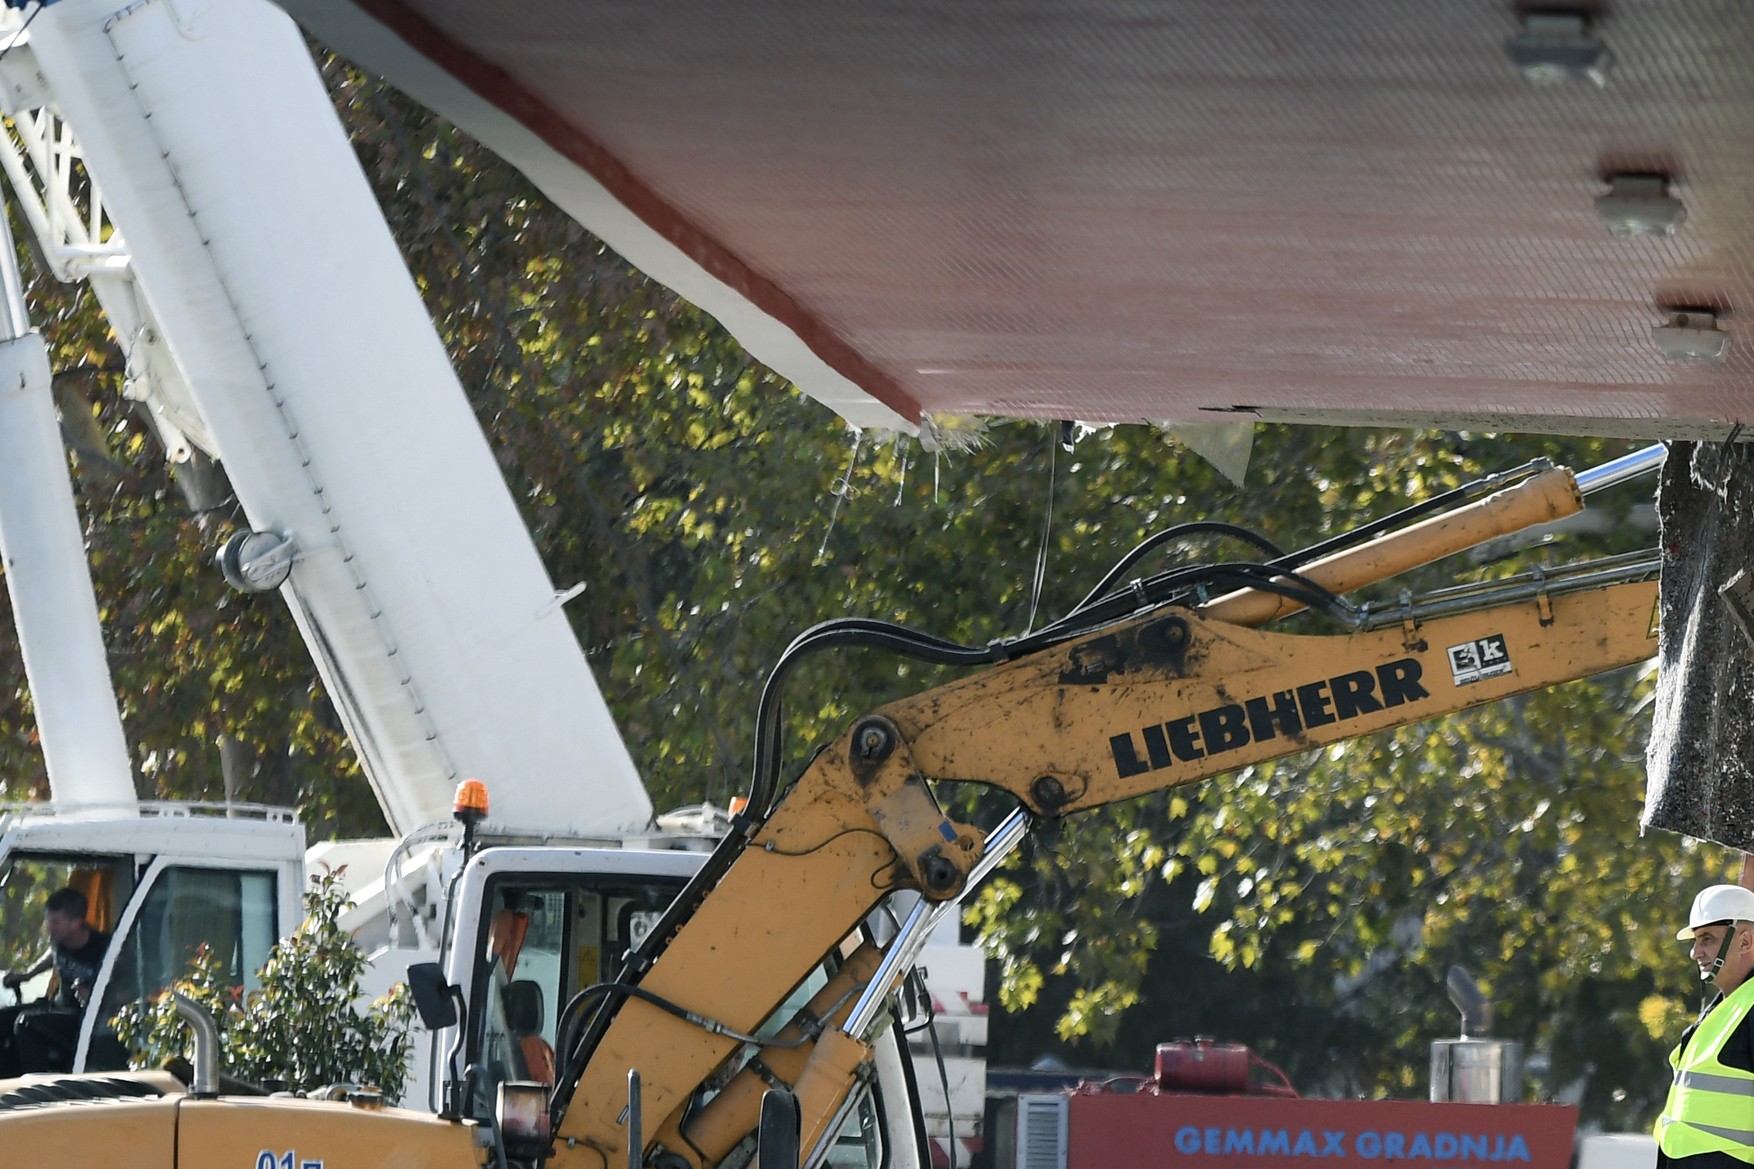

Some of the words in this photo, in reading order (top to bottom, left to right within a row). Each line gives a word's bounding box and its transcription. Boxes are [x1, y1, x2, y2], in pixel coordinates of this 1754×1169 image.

[1109, 658, 1430, 779] LIEBHERR
[1174, 1125, 1347, 1157] GEMMAX
[1355, 1130, 1532, 1162] GRADNJA
